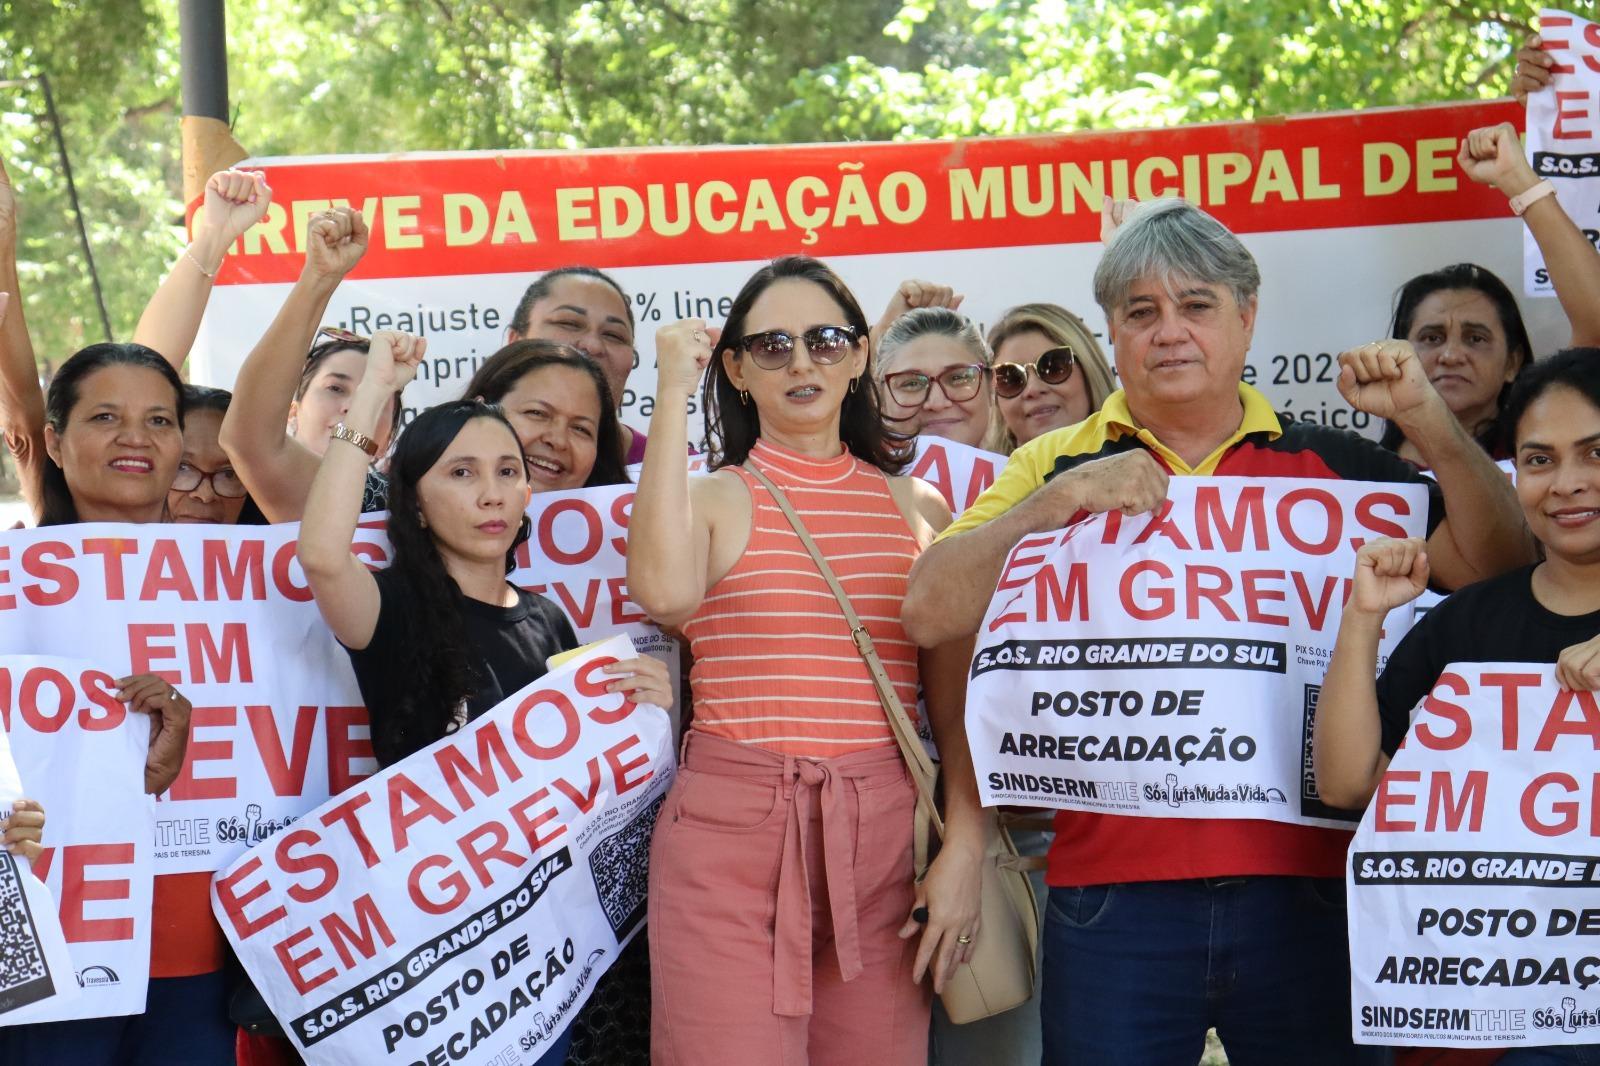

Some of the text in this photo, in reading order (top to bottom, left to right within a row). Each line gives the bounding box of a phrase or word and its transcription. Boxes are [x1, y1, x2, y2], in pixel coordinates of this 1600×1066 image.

[1540, 156, 1599, 174] S.O.S.
[444, 191, 535, 247] DA
[556, 161, 926, 245] EDUCAÇÃO
[949, 146, 1340, 220] MUNICIPAL
[1363, 137, 1457, 196] DE
[351, 303, 500, 337] Reajuste
[1272, 353, 1334, 385] 202
[997, 486, 1411, 592] EAMOS
[1119, 560, 1385, 640] GREV
[127, 623, 254, 684] EM
[977, 643, 1280, 670] S.O.S. RIO GRANDE DO SUL
[1295, 645, 1307, 654] PIX
[1308, 647, 1328, 658] S.O.S.
[1297, 656, 1315, 665] Chave
[1031, 690, 1204, 717] POSTO DE
[1399, 672, 1600, 752] STA
[999, 727, 1256, 767] ARRECADAÇÃO
[216, 655, 638, 941] ESTAMOS
[1375, 770, 1600, 837] EM G
[273, 734, 654, 996] EM GREVE
[1360, 858, 1420, 879] S.O.S.
[1424, 858, 1467, 879] RIO
[1471, 859, 1587, 881] GRANDE
[303, 856, 564, 1039] S.O.S. RIO GRANDE DO SUL
[1417, 908, 1600, 937] POSTO DE
[382, 933, 531, 1054] POSTO DE
[1375, 956, 1600, 990] ARRECADAÇ
[408, 937, 574, 1066] ECADAÇÃO
